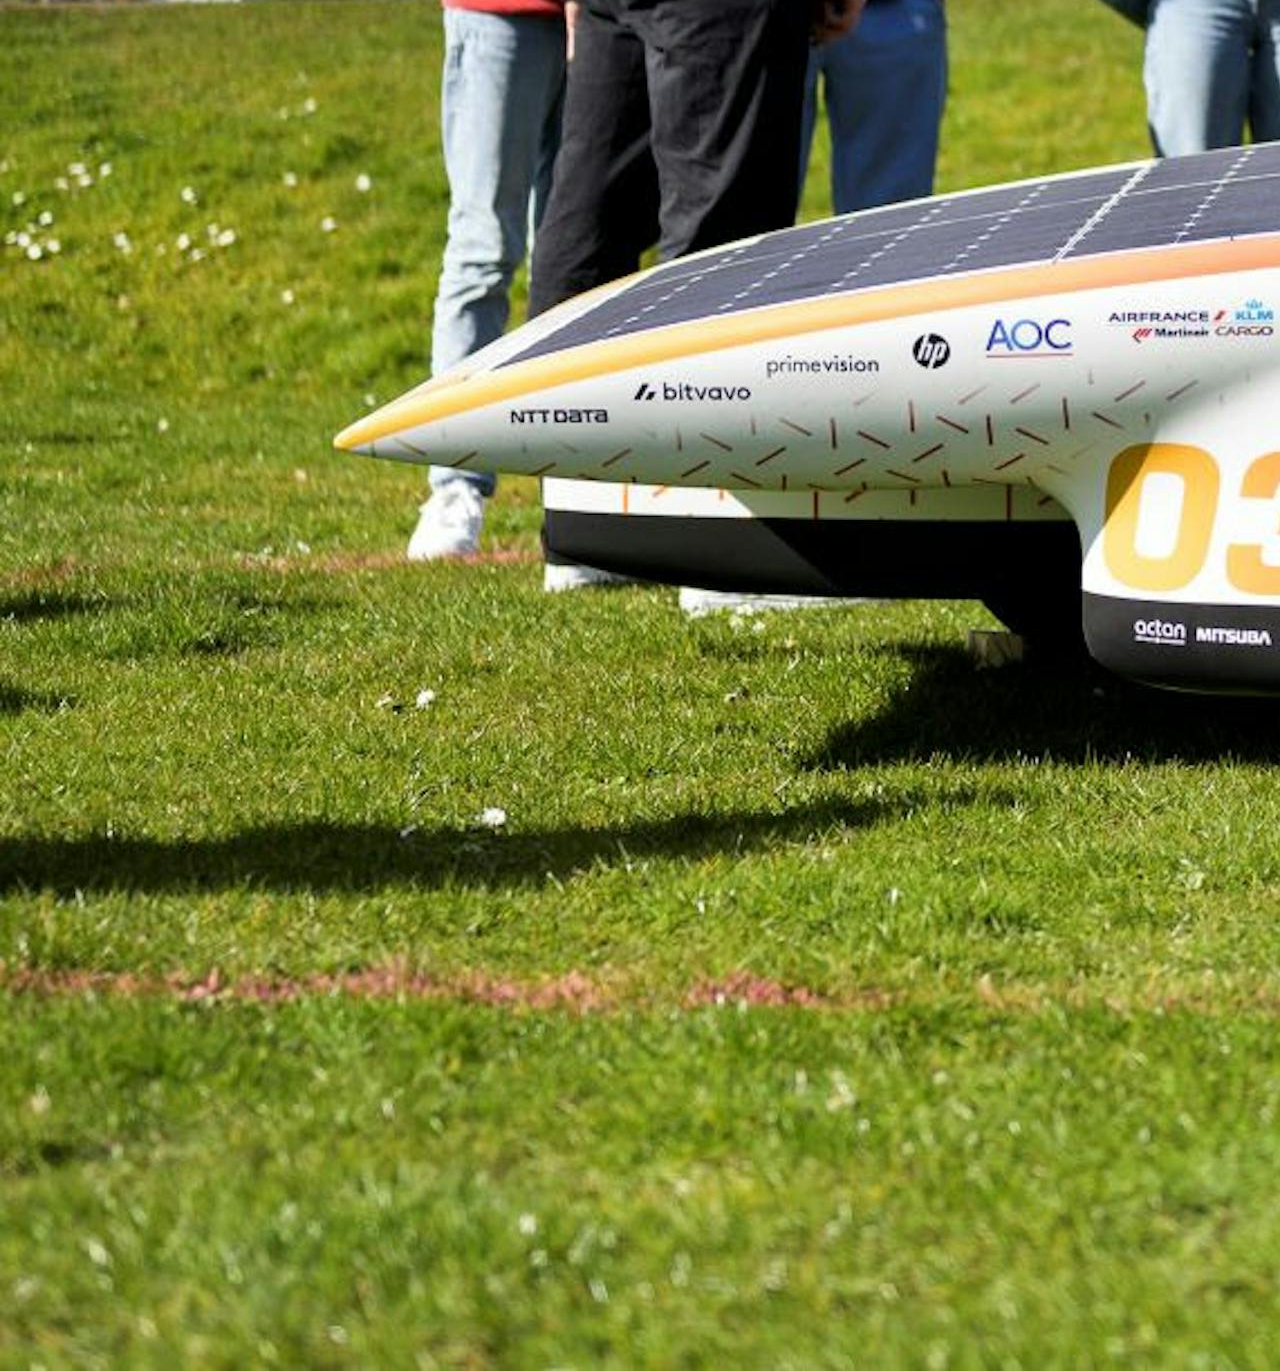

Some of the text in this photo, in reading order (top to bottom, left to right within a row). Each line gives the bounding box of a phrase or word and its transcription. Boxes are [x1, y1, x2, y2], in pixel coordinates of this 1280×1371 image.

[1236, 311, 1274, 321] KLM
[986, 319, 1074, 351] AOC
[1214, 326, 1274, 336] CARGO
[914, 333, 949, 369] hp
[766, 355, 880, 378] primevision
[663, 382, 751, 401] bitvavo
[510, 410, 549, 424] NTT
[1196, 627, 1272, 646] MITSUBA
